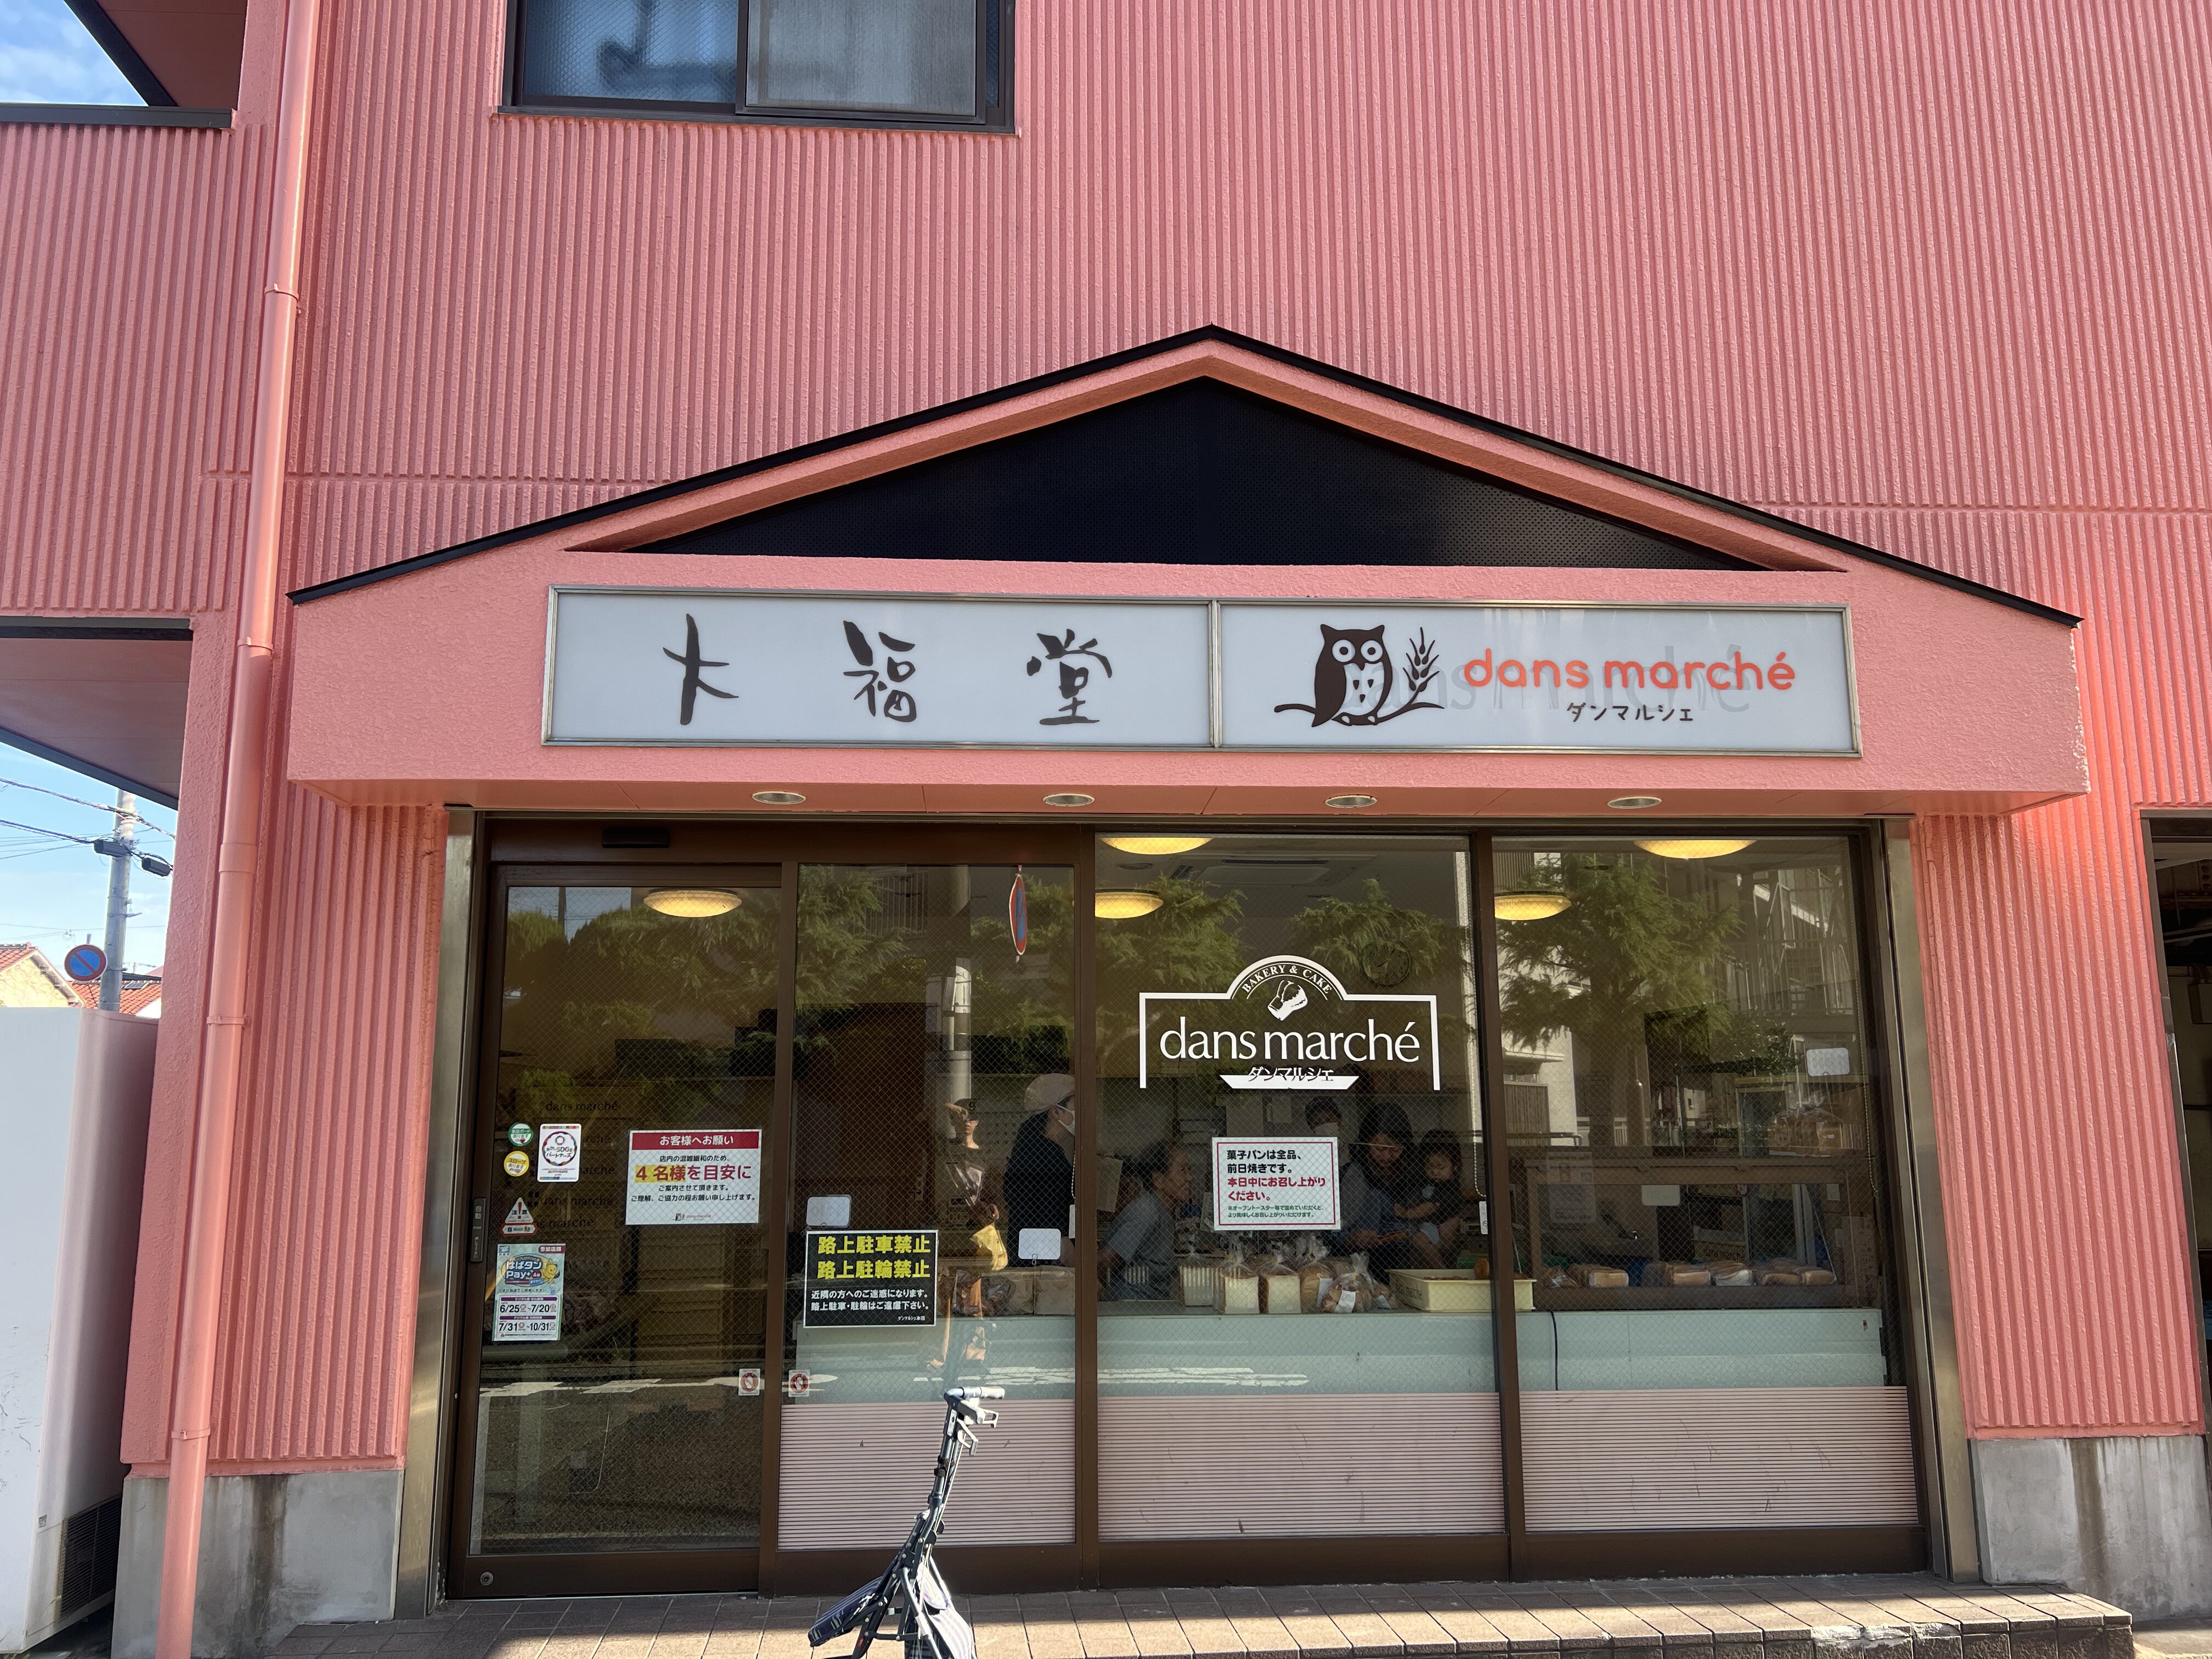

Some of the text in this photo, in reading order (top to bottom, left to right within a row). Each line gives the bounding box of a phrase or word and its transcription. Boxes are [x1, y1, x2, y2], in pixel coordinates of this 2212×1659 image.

[1464, 648, 1796, 691] dans marché
[1566, 701, 1694, 723] ダンマルシェ
[1242, 964, 1333, 995] BAKERY & CAKE
[1159, 1016, 1420, 1063] dans marché
[1248, 1066, 1334, 1082] ダンマルシェ
[659, 1135, 733, 1146] お客様へお願い
[1227, 1149, 1302, 1160] 菓子パンは全品、
[1227, 1163, 1292, 1174] 前日焼きです。
[1227, 1177, 1326, 1187] 本日中にお召し上がり
[1227, 1190, 1271, 1201] ください。
[817, 1235, 931, 1255] 路上駐車禁止
[506, 1261, 542, 1270] はばタン
[817, 1259, 930, 1279] 路上駐輪禁止
[811, 1289, 928, 1300] 近隣の方へのご迷惑になります。
[500, 1305, 520, 1313] 6/25
[531, 1304, 550, 1313] 7/20
[810, 1301, 929, 1311] 路上駐車・駐輪はご遠慮下さい。
[499, 1323, 517, 1331] 7/31
[530, 1323, 549, 1331] 10/31
